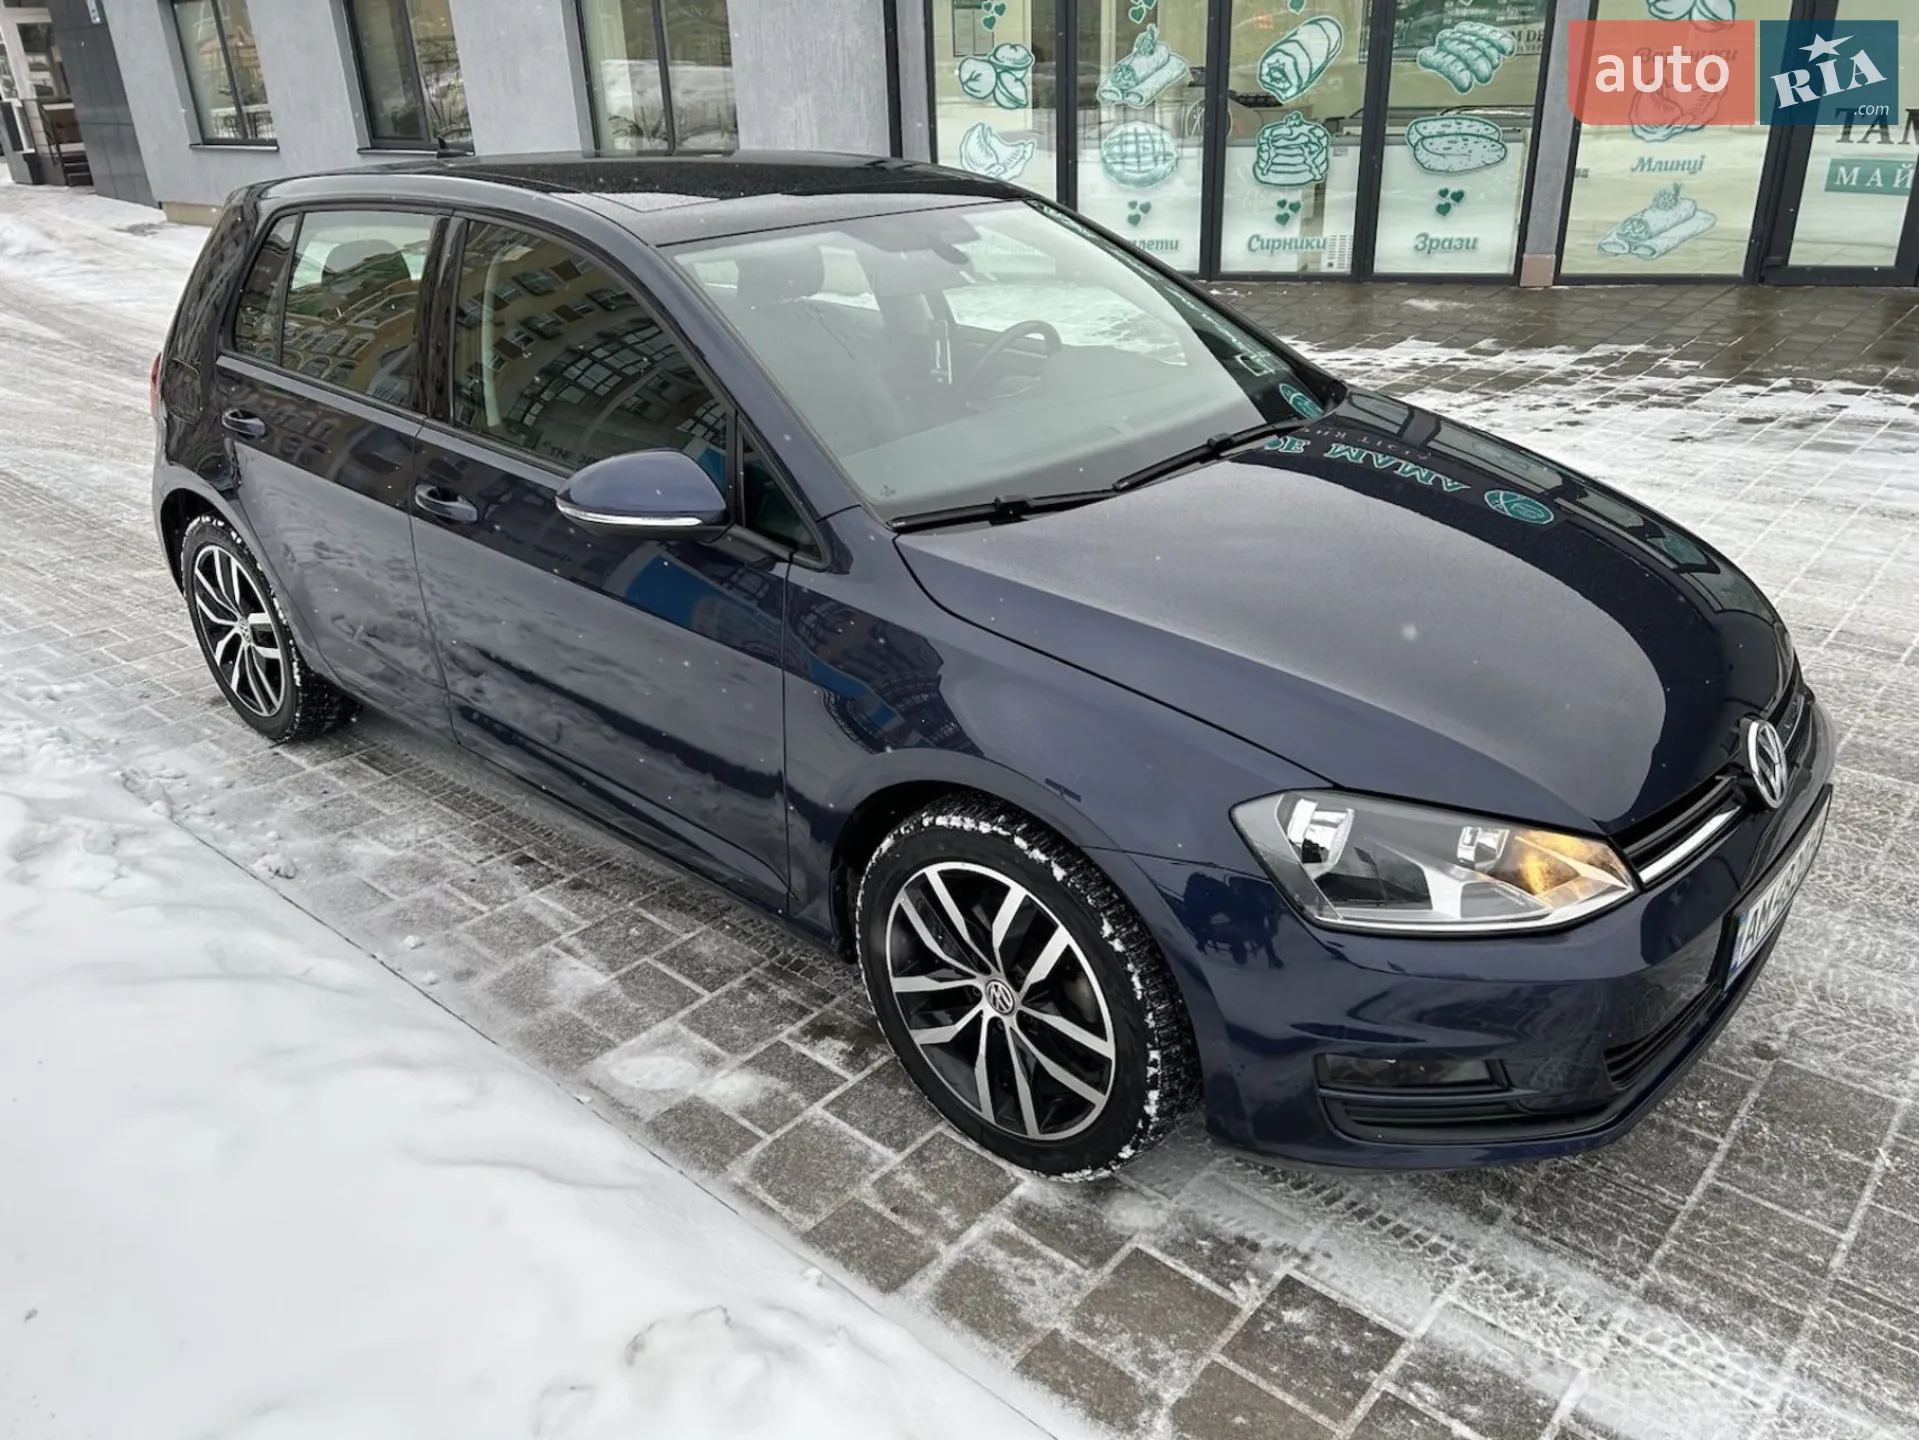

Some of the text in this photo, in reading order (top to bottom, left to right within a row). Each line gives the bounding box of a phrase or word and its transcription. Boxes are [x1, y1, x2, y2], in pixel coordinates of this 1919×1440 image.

[1630, 154, 1707, 175] Млинці
[1247, 233, 1328, 254] Сирники
[1414, 231, 1479, 254] Зрази
